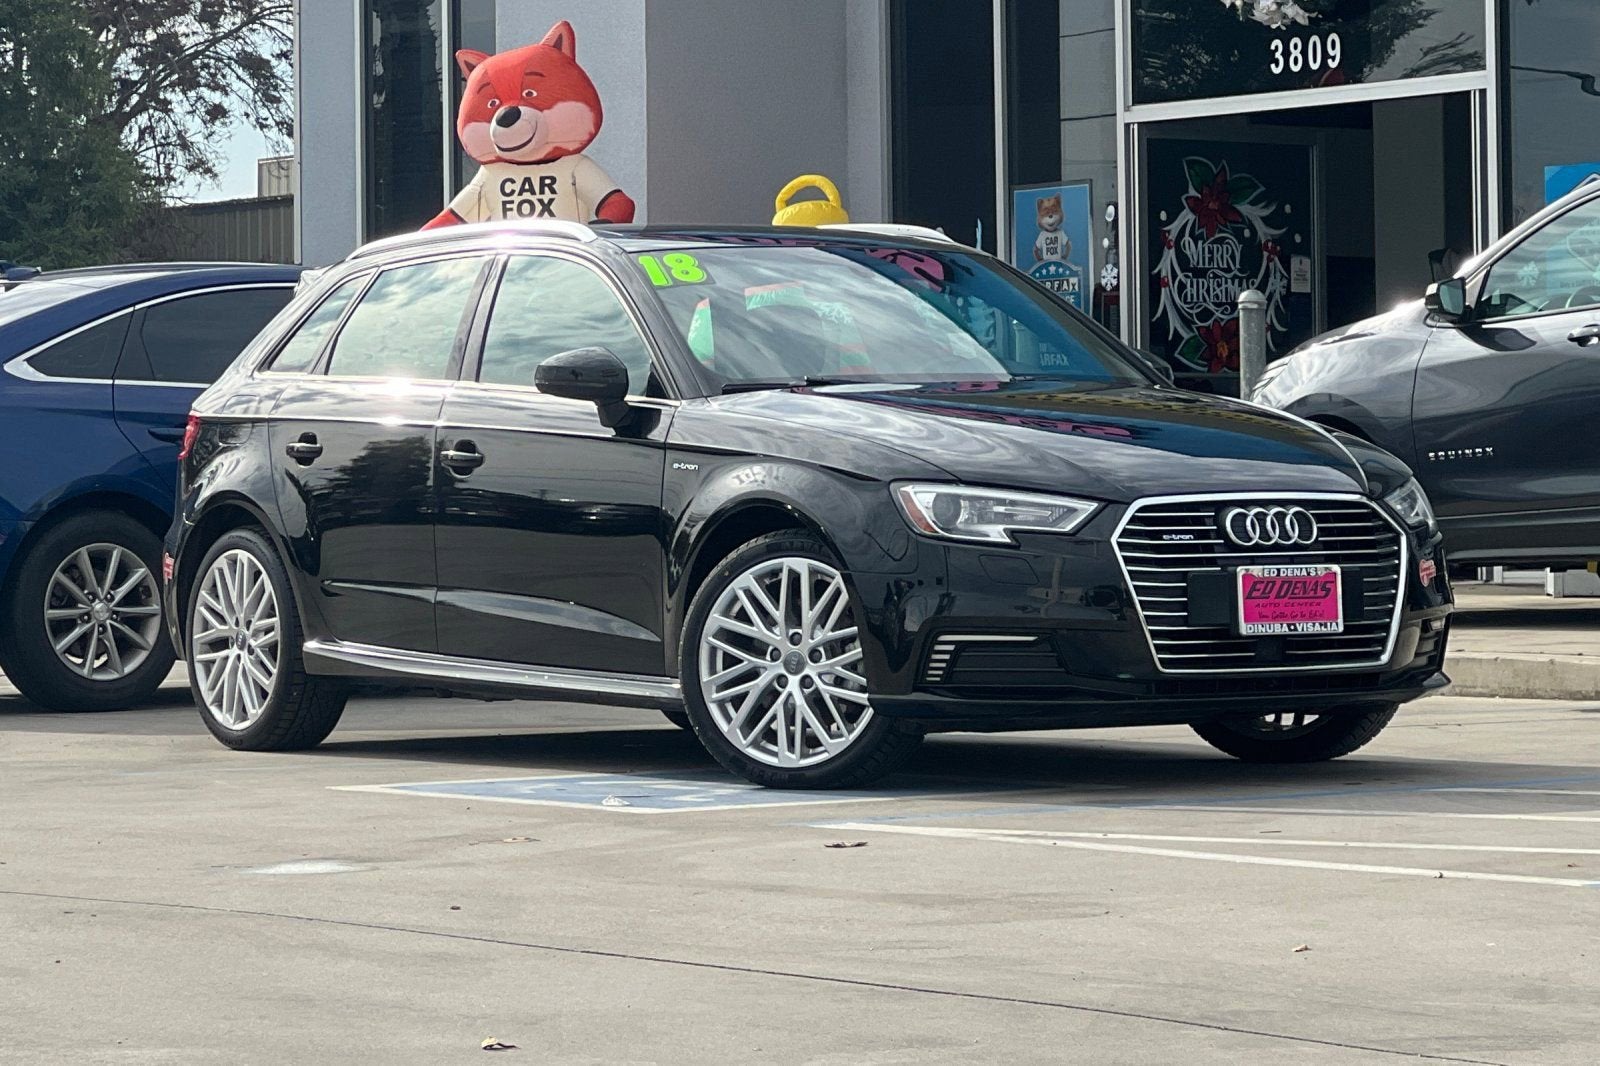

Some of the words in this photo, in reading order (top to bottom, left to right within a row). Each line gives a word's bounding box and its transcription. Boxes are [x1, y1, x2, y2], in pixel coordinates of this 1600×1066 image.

[1270, 32, 1341, 75] 3809
[499, 175, 558, 198] CAR
[501, 197, 557, 220] FOX
[1044, 235, 1060, 247] CAR
[1045, 246, 1060, 257] FOX
[1181, 234, 1243, 269] MERRY
[638, 252, 707, 286] 18
[672, 462, 699, 471] e-tron
[1263, 568, 1277, 577] ED
[1280, 567, 1316, 577] DENA'S
[1246, 580, 1277, 600] ED
[1247, 624, 1289, 633] DINUBA
